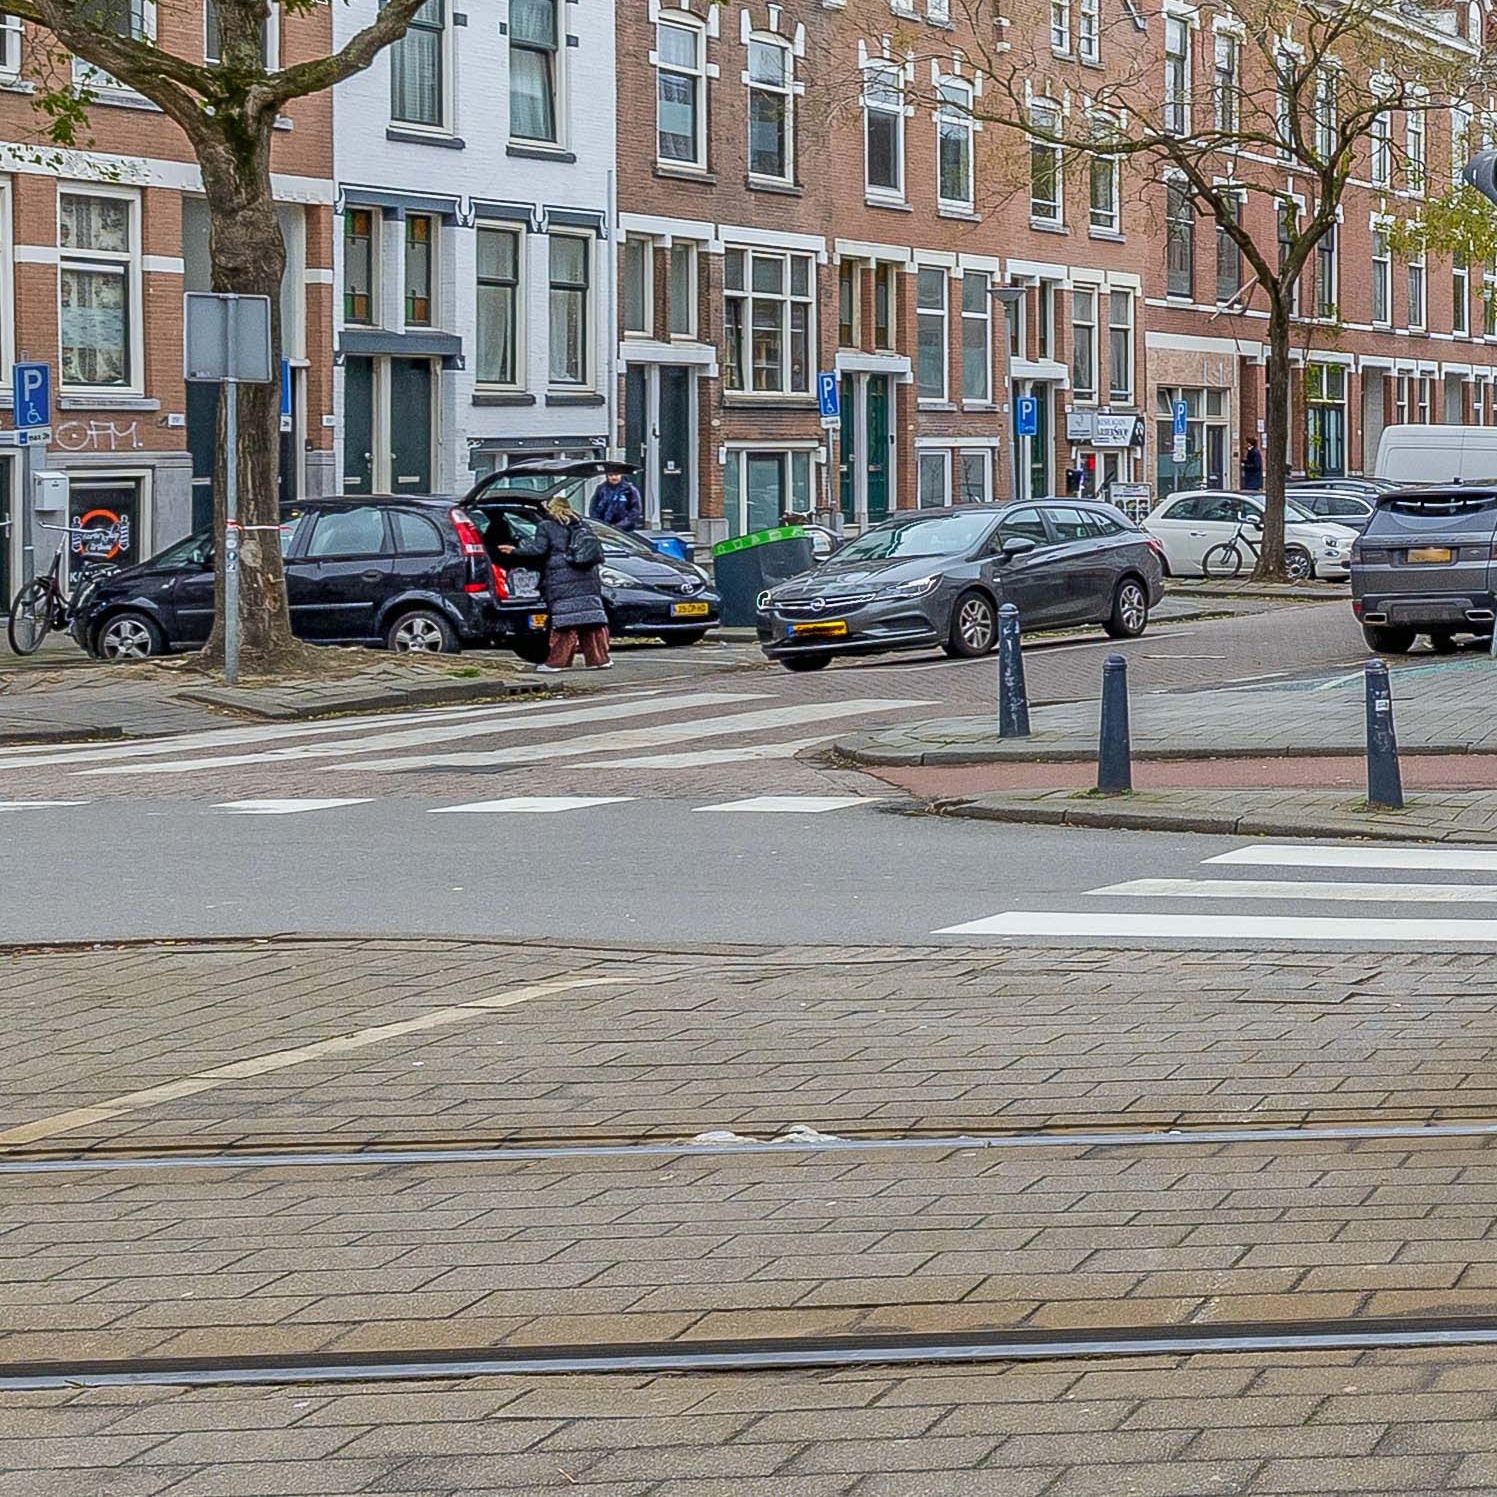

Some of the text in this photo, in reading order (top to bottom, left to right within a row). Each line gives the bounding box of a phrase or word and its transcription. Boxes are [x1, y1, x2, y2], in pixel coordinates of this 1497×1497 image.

[24, 369, 42, 401] P
[824, 377, 833, 399] P
[1022, 402, 1032, 420] P
[1178, 404, 1185, 418] P
